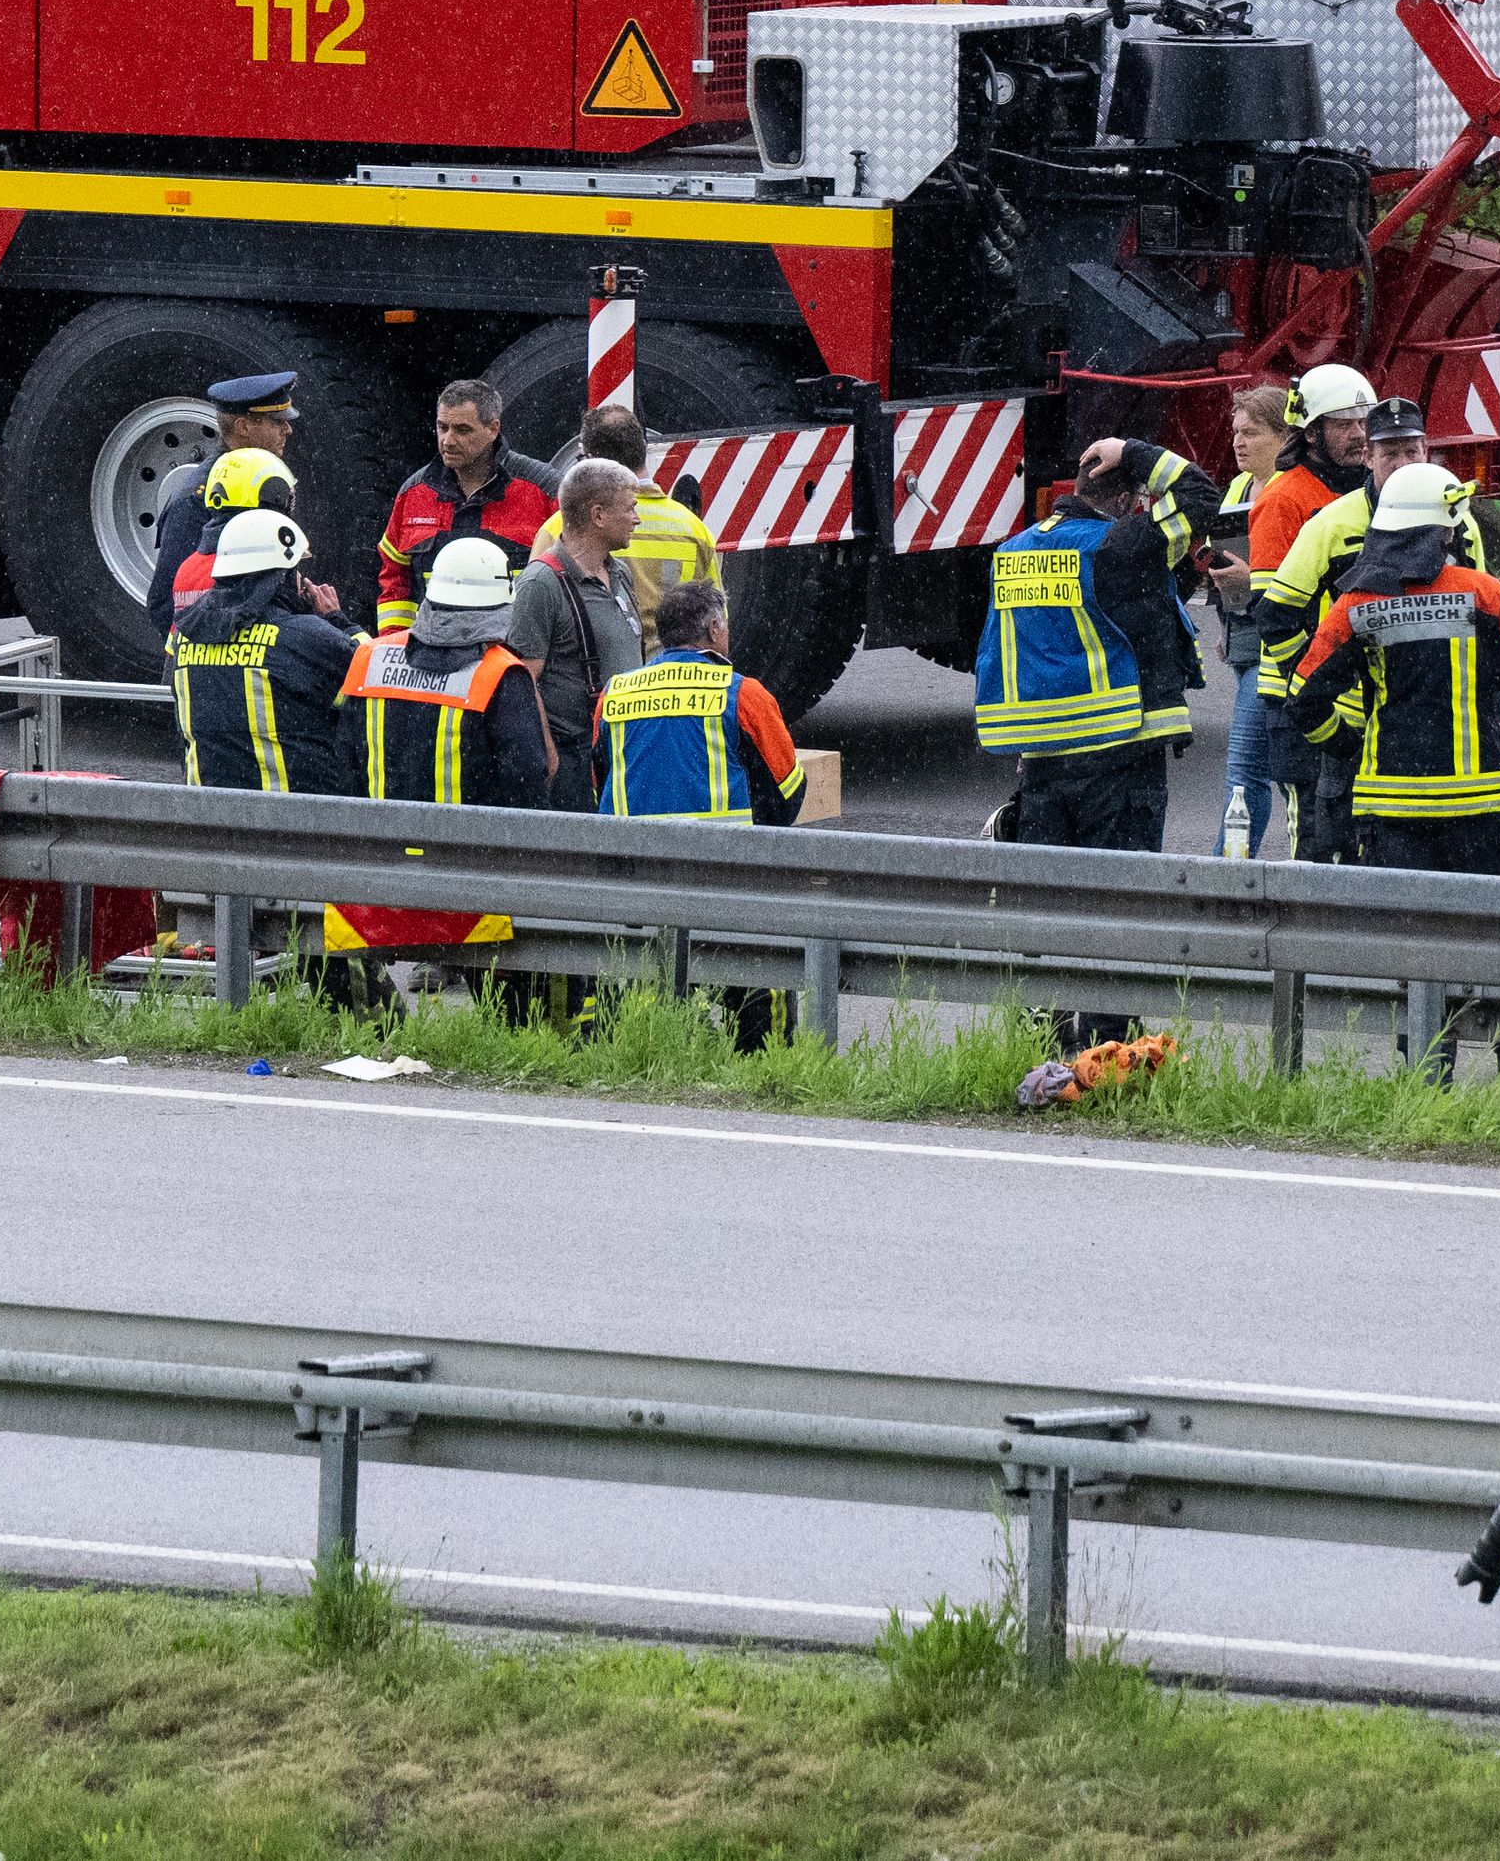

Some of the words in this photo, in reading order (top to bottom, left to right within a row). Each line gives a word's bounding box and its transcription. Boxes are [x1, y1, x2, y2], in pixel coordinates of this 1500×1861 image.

[997, 555, 1078, 575] FEUERWEHR
[998, 583, 1049, 603] Garmisch
[1054, 583, 1080, 602] 40/1
[1357, 594, 1466, 617] FEUERWEHR
[1366, 609, 1460, 629] GARMISCH
[177, 642, 267, 668] GARMISCH
[382, 666, 450, 692] GARMISCH
[613, 665, 728, 690] Gruppenführer
[606, 694, 680, 716] Garmisch
[687, 693, 723, 712] 41/1
